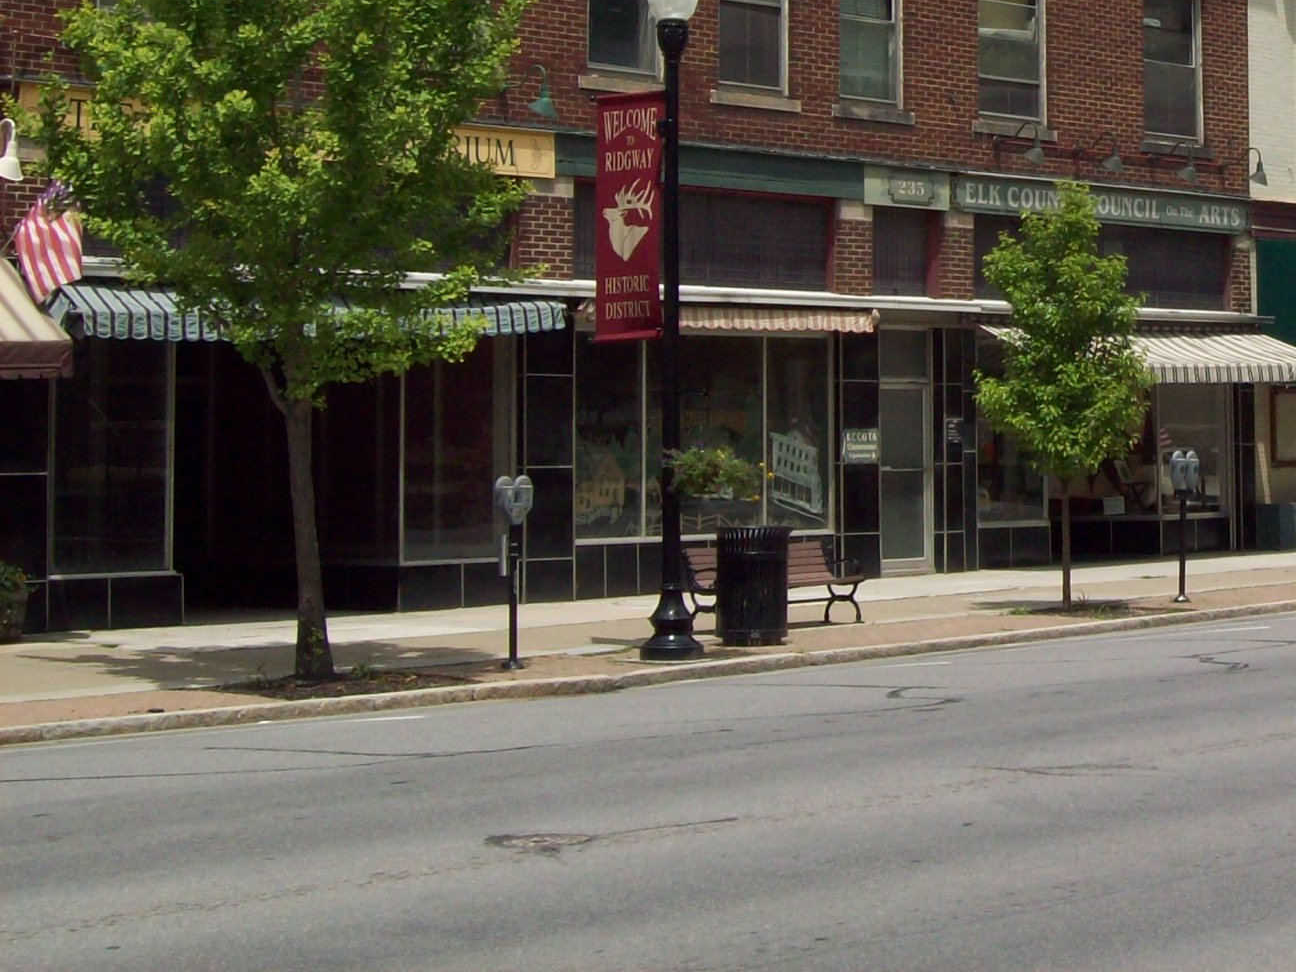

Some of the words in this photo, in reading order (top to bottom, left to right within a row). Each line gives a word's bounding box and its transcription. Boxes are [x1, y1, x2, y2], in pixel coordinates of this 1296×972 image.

[603, 107, 657, 144] WELCOME
[626, 135, 635, 145] TO
[605, 148, 654, 172] RIDGWAY
[898, 180, 925, 196] 235
[964, 182, 1002, 206] ELK
[1007, 186, 1061, 210] COUN
[1166, 205, 1178, 217] On
[1180, 207, 1195, 219] The
[1198, 205, 1241, 227] ARTS
[604, 274, 650, 295] HISTORIC
[605, 300, 651, 320] DISTRICT
